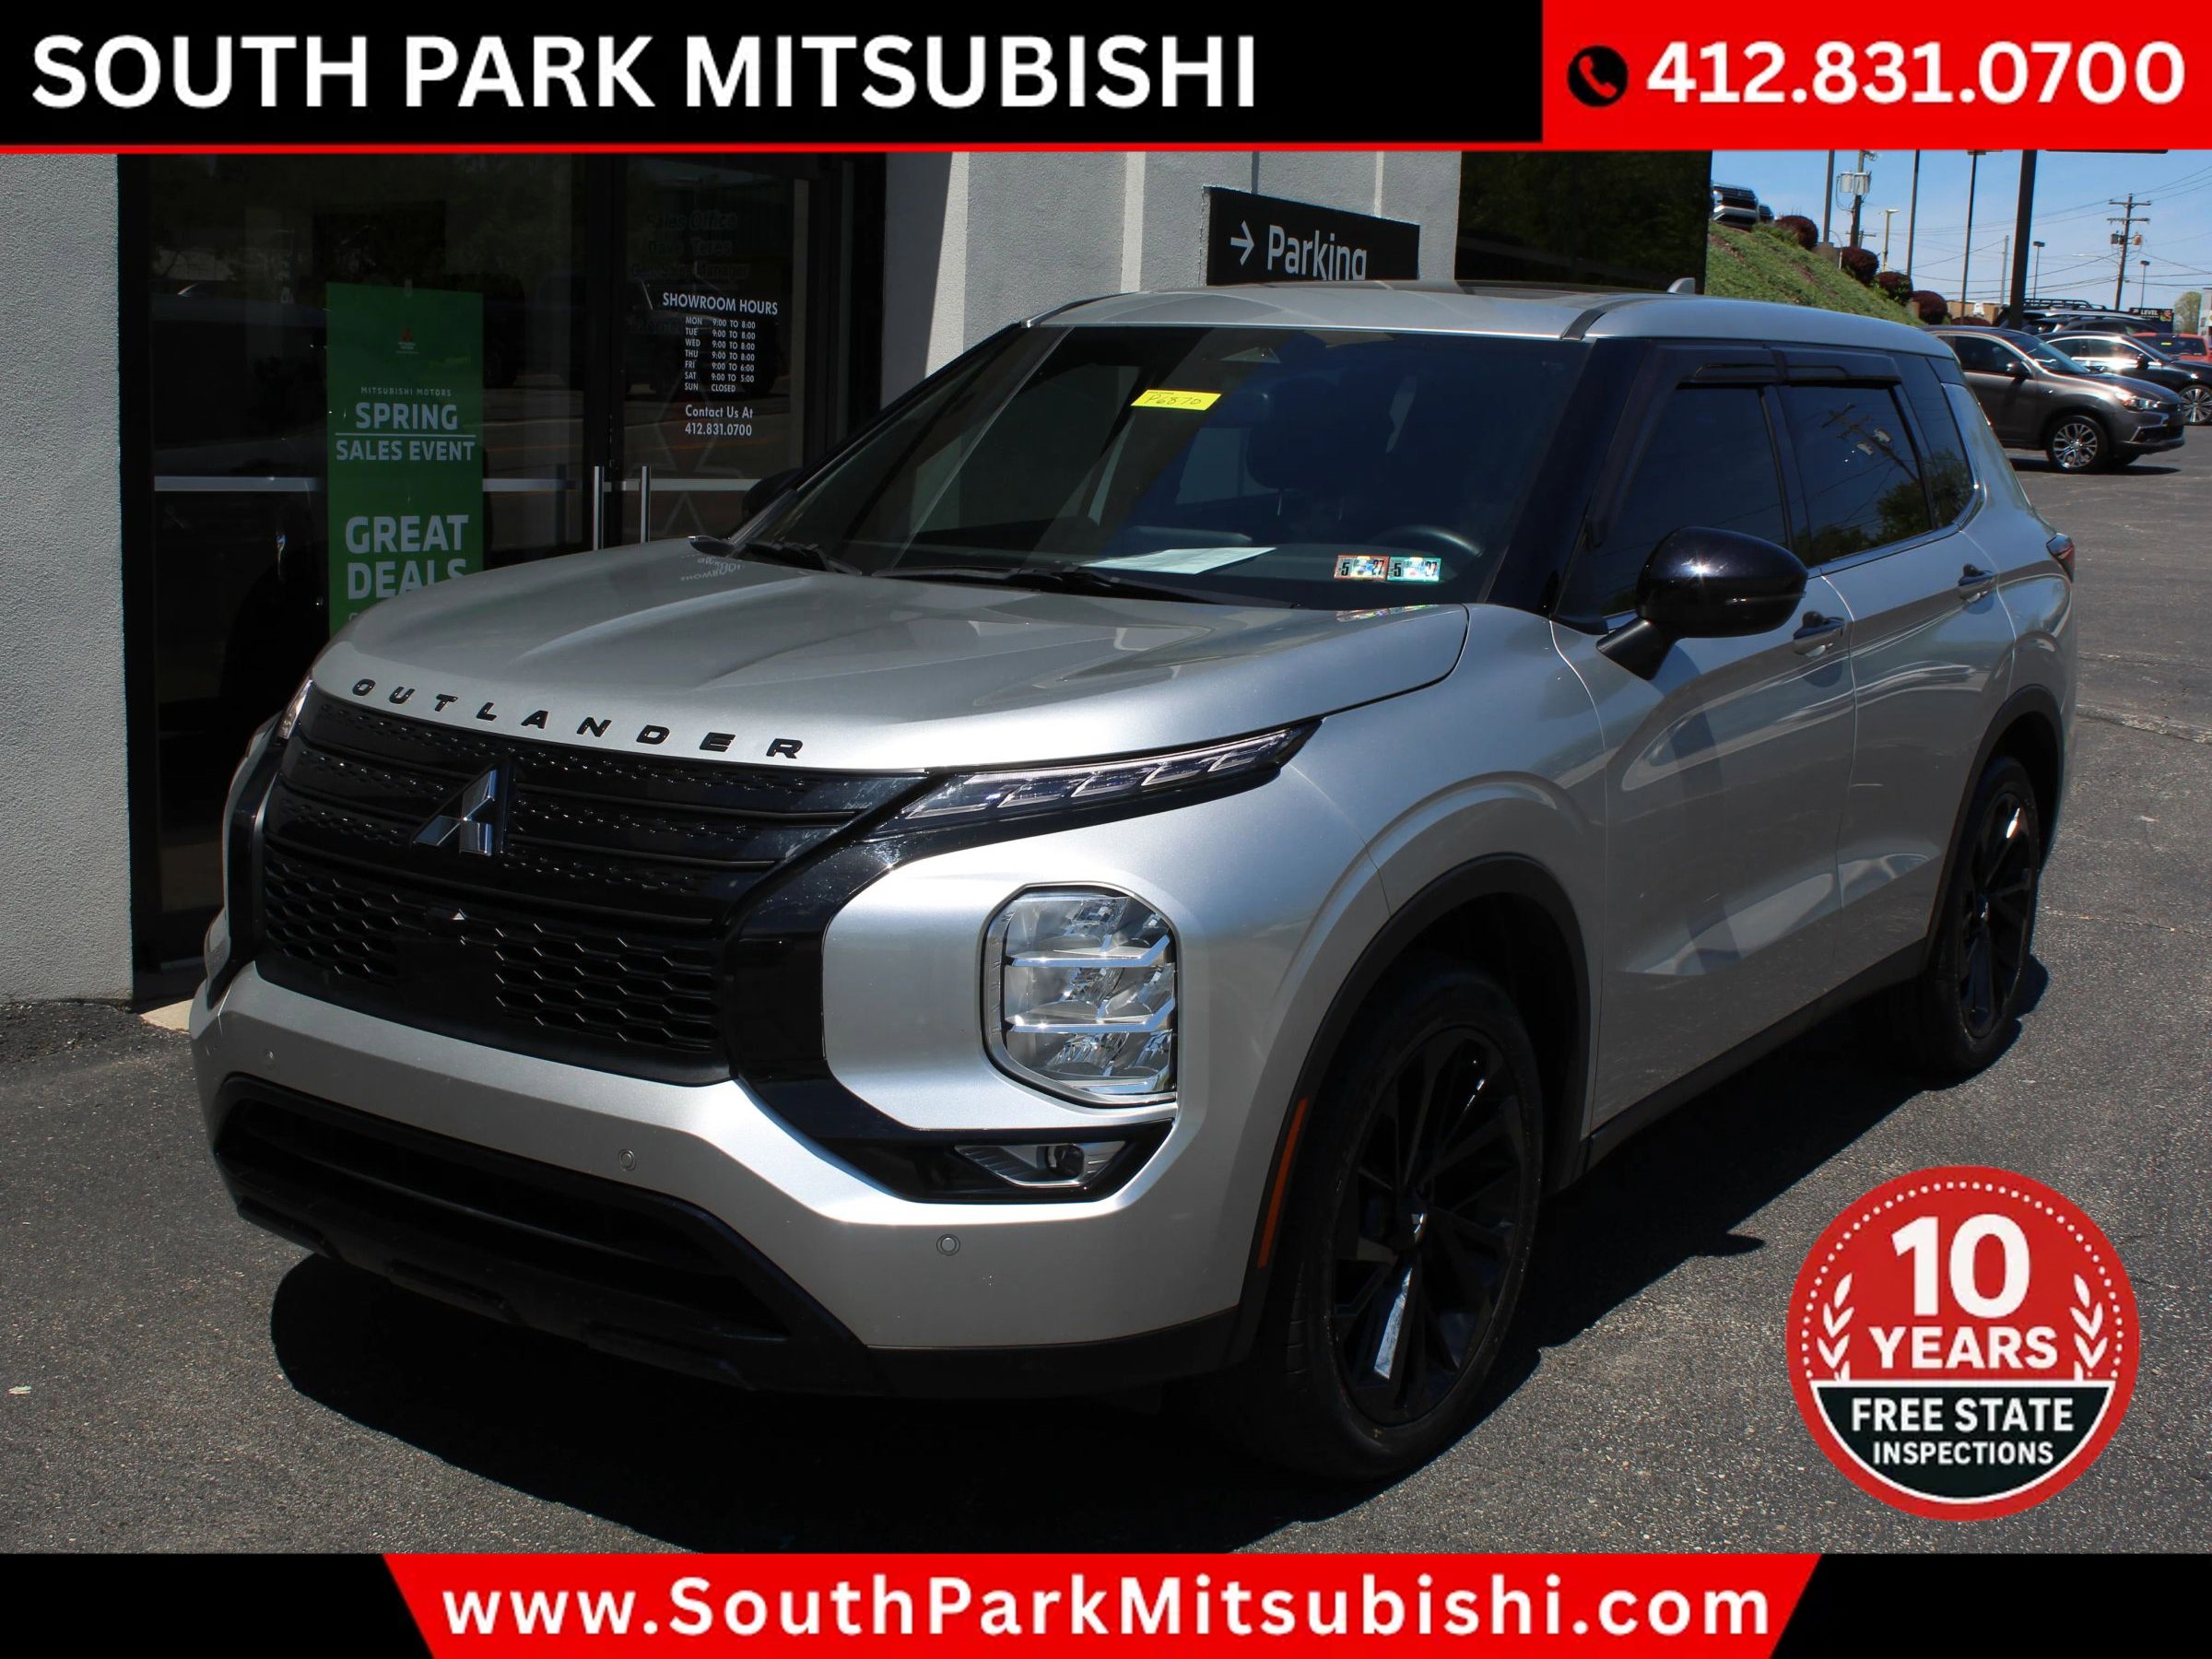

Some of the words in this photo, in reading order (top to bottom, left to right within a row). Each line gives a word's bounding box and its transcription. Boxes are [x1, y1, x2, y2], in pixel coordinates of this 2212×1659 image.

[1267, 224, 1368, 281] Parking
[663, 292, 736, 312] SHOWROOM
[739, 299, 778, 315] HOURS
[742, 321, 756, 329] 8:00
[686, 327, 697, 335] TUE
[712, 330, 726, 338] 9:00
[741, 332, 755, 340] 8:00
[730, 341, 737, 349] TO
[712, 351, 726, 359] 9:00
[729, 352, 737, 360] TO
[741, 353, 755, 361] 8:00
[685, 360, 696, 369] FRI
[712, 361, 725, 371] 9:00
[741, 364, 754, 372] 6:00
[712, 373, 724, 382] 9:00
[728, 373, 736, 382] TO
[360, 386, 413, 396] MITSUBISHI
[417, 389, 453, 397] MOTORS
[685, 382, 698, 391] SUN
[712, 383, 735, 393] CLOSED
[355, 402, 458, 431] SPRING
[686, 404, 723, 417] Contact
[726, 406, 739, 418] Us
[742, 406, 754, 418] At
[685, 422, 752, 436] 412.831.0700
[335, 440, 403, 462] SALES
[409, 441, 476, 462] EVENT
[345, 514, 469, 555] GREAT
[352, 678, 804, 759] OUTLANDER
